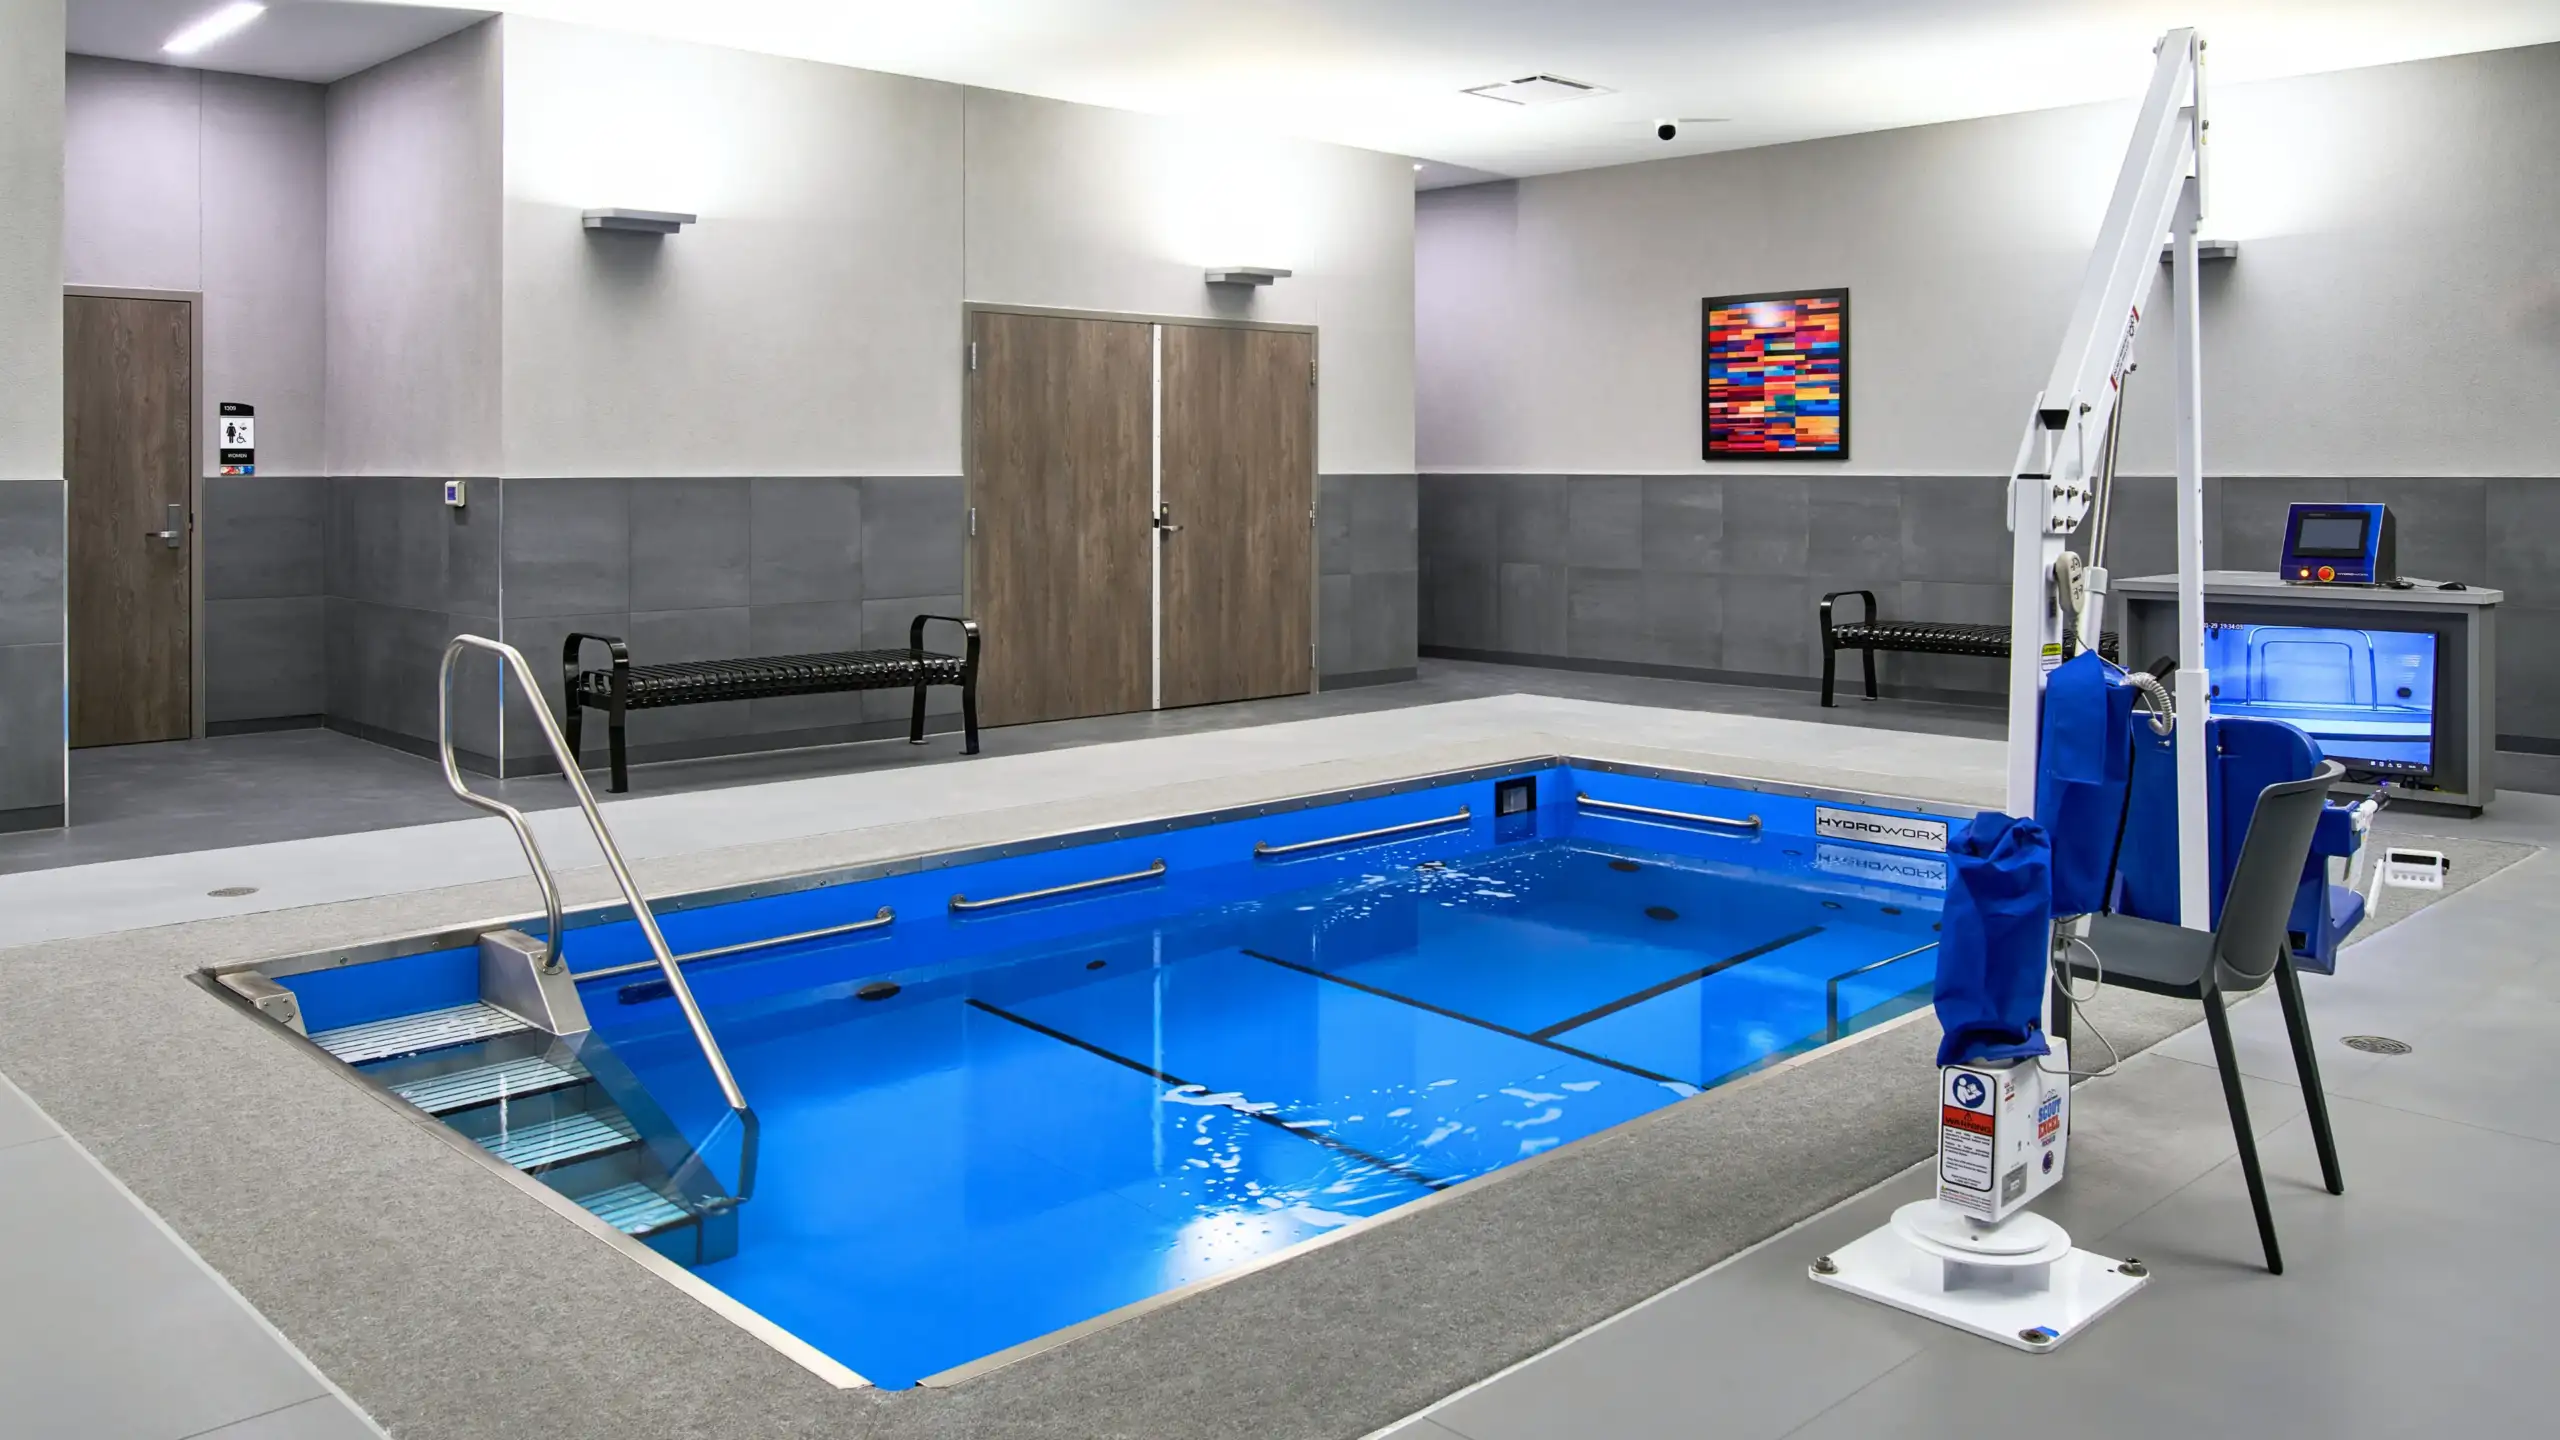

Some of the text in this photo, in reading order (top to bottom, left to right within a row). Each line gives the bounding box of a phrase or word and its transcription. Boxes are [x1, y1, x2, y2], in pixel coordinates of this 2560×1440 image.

[1818, 817, 1943, 842] HYDROWORX
[2038, 1097, 2062, 1123] SCOUT
[1945, 1116, 1992, 1133] WARNING
[2038, 1115, 2060, 1139] EXCEL
